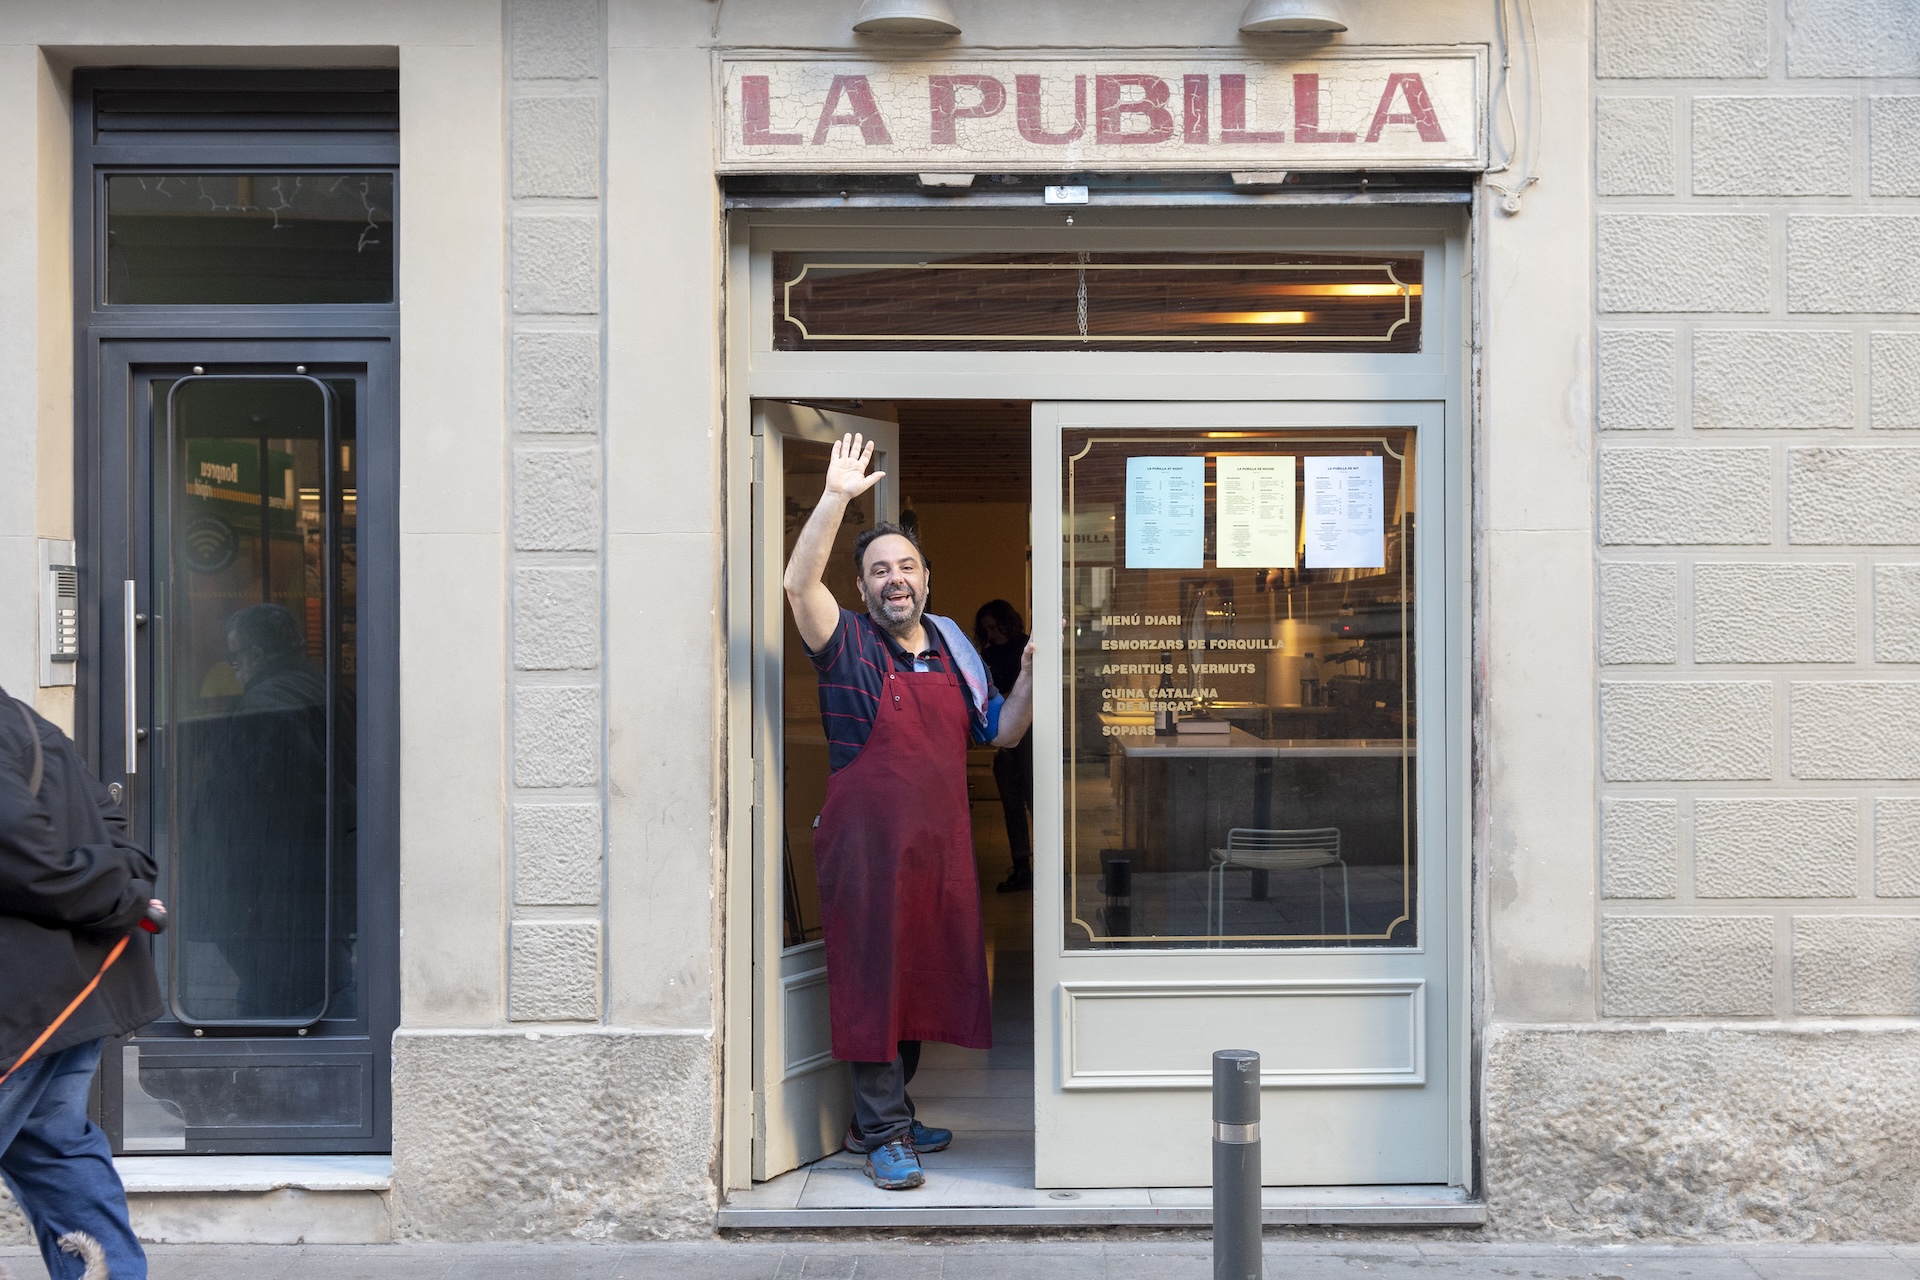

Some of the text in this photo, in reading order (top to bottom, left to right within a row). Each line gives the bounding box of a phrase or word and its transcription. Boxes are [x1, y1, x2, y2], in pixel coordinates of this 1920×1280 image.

[741, 72, 1448, 146] LA PUBILLA
[1063, 534, 1110, 543] UBILLA
[1101, 613, 1182, 626] MENÚ DIARI
[1101, 639, 1285, 651] ESMORZARS DE FORQUILLA
[1101, 663, 1256, 674] APERITIUS & VERMUTS
[1102, 688, 1218, 699] CUINA CATALANA
[1102, 701, 1194, 712] & DE MERCAT
[1102, 725, 1156, 736] SOPARS
